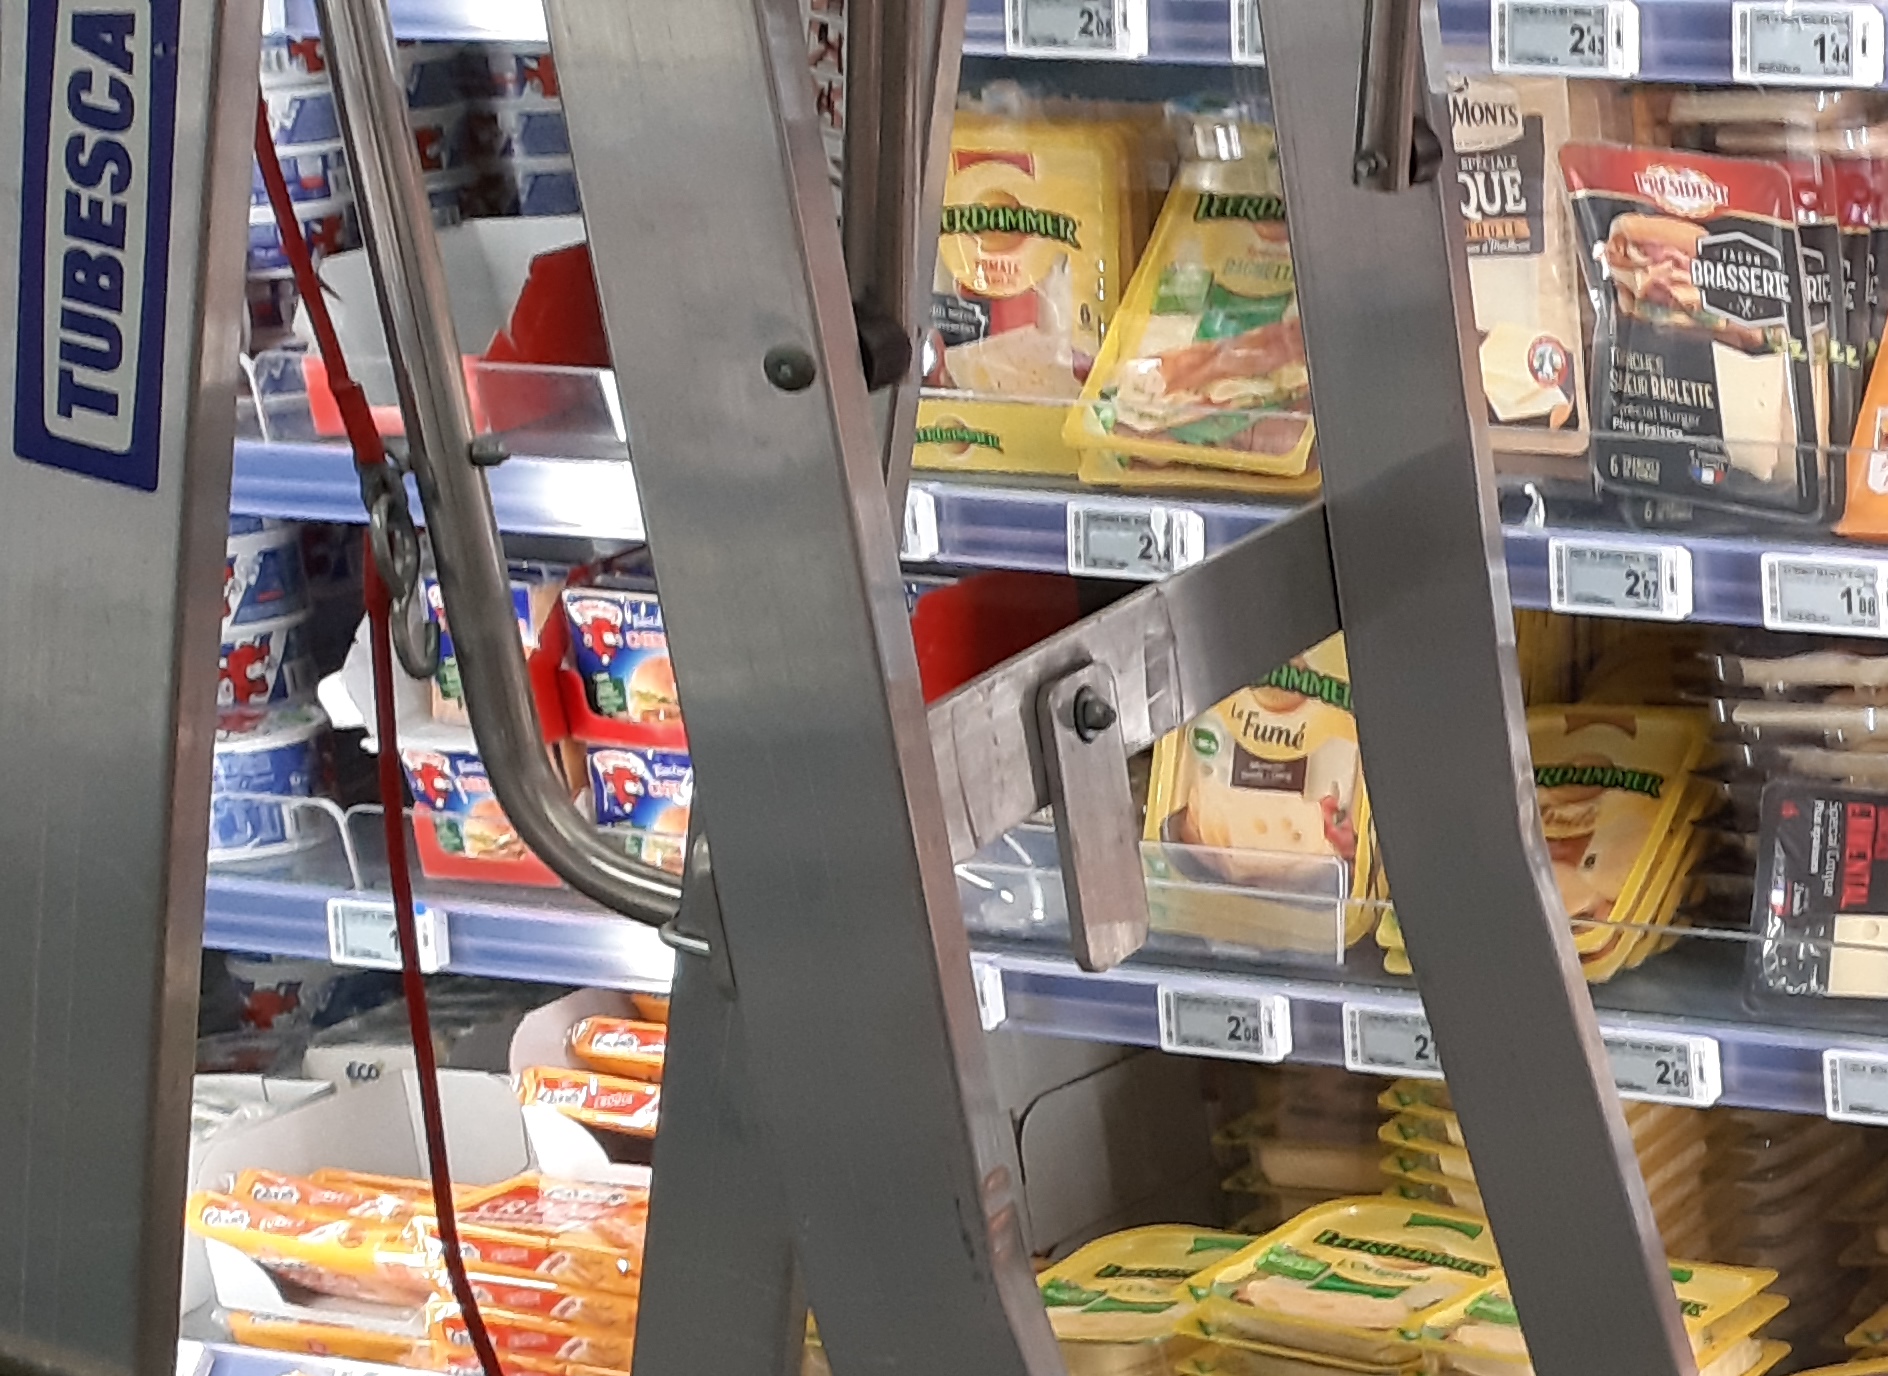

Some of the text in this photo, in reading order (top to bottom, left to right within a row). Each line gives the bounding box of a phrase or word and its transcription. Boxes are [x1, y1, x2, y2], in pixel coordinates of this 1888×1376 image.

[58, 12, 136, 423] TUBESCA
[1691, 256, 1791, 304] BRASSERIE
[1242, 710, 1306, 751] Fumé
